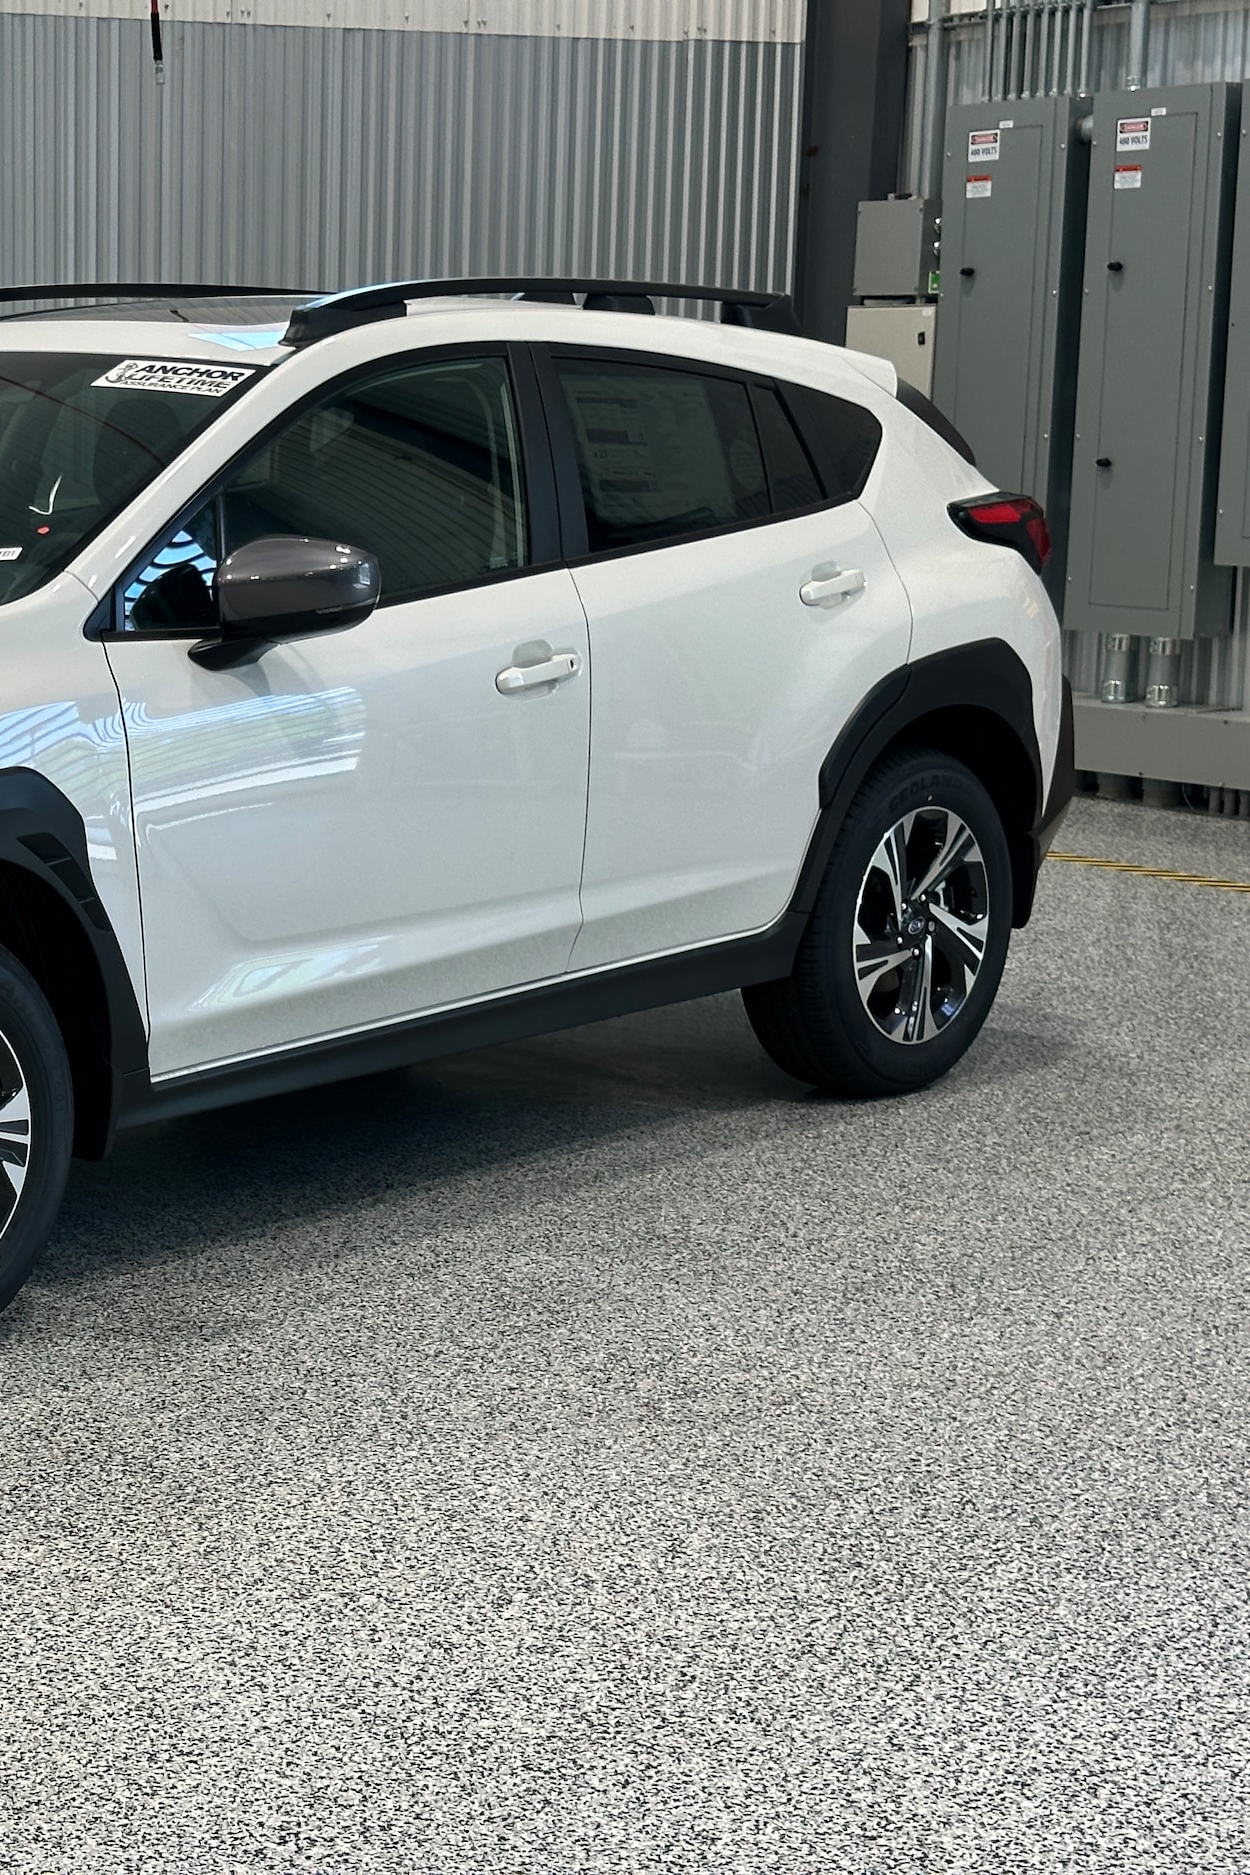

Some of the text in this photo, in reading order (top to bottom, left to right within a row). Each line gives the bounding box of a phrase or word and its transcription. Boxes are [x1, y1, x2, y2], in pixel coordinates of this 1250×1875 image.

[1131, 134, 1148, 144] VOLTS
[981, 146, 997, 155] VOLTS
[135, 364, 245, 381] ANCHOR
[119, 381, 223, 394] ASSURANCE PLAN
[127, 373, 233, 389] LIFETIME
